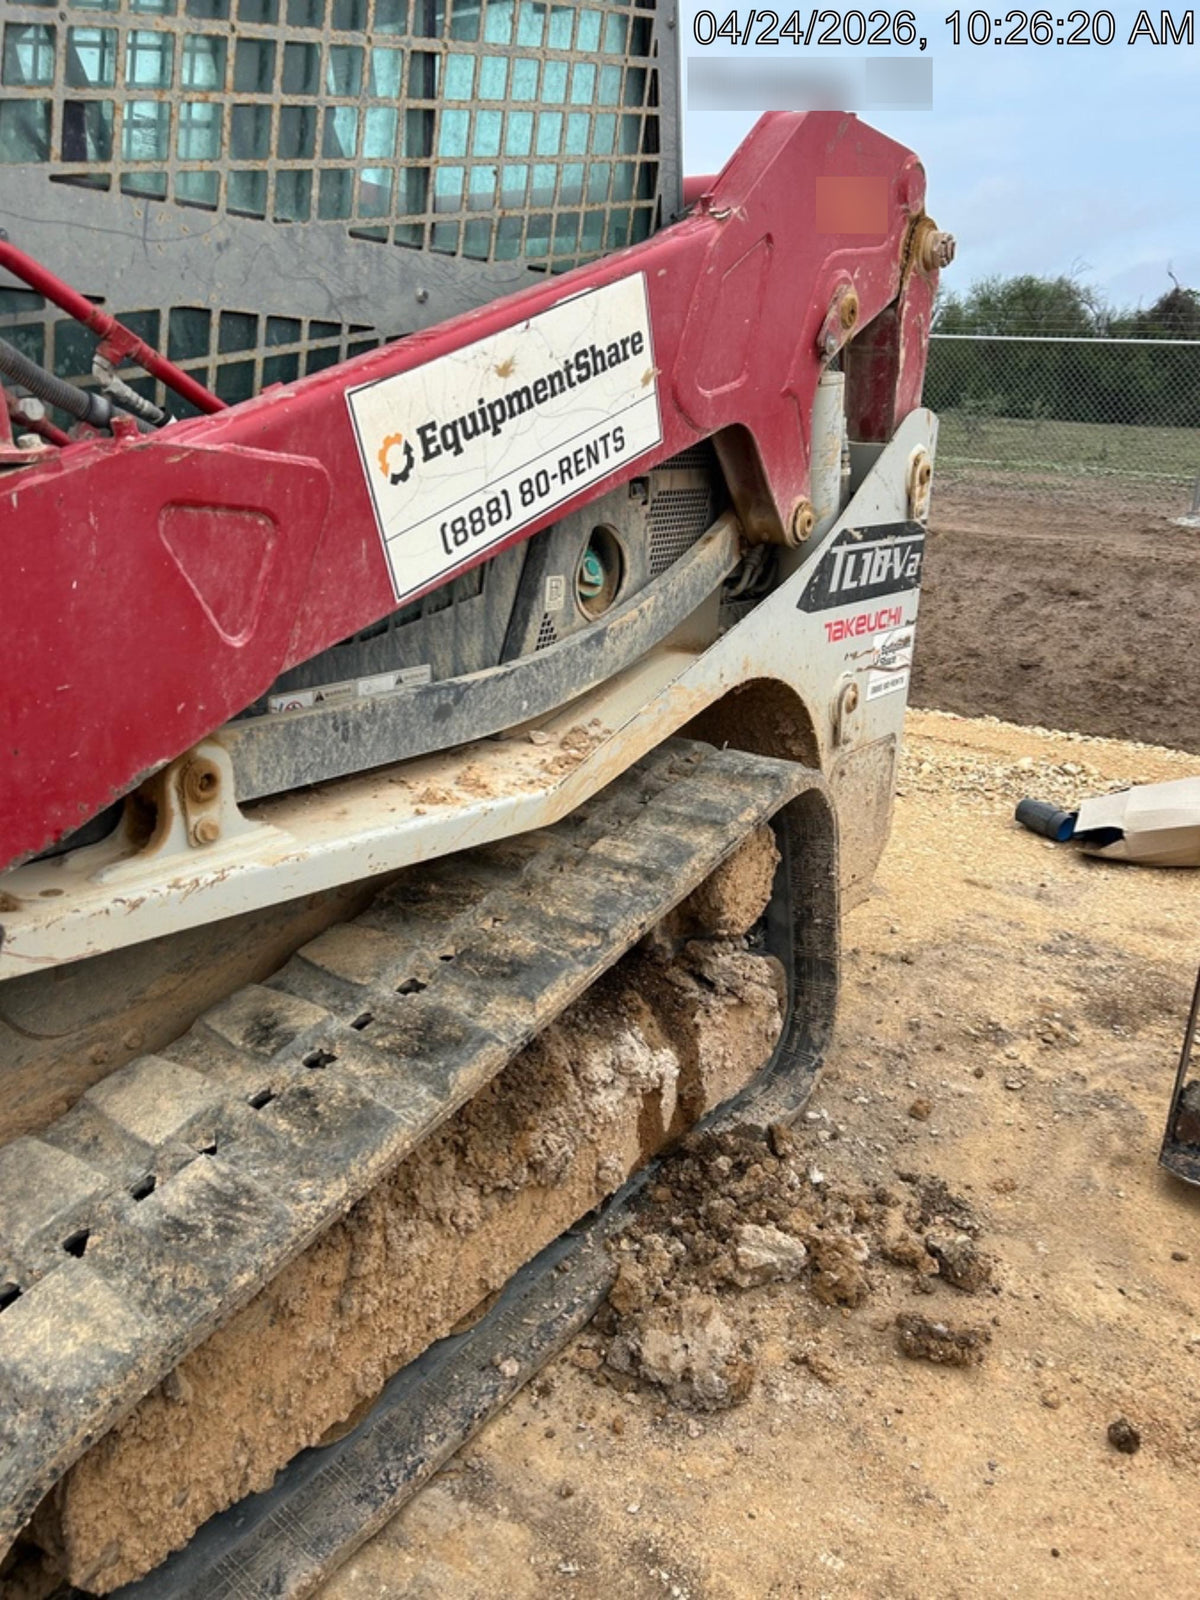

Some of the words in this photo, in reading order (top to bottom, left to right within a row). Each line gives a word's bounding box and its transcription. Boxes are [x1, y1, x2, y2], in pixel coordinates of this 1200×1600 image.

[416, 330, 644, 463] EquipmentShare
[439, 489, 513, 555] (888)
[518, 425, 626, 508] 80-RENTS
